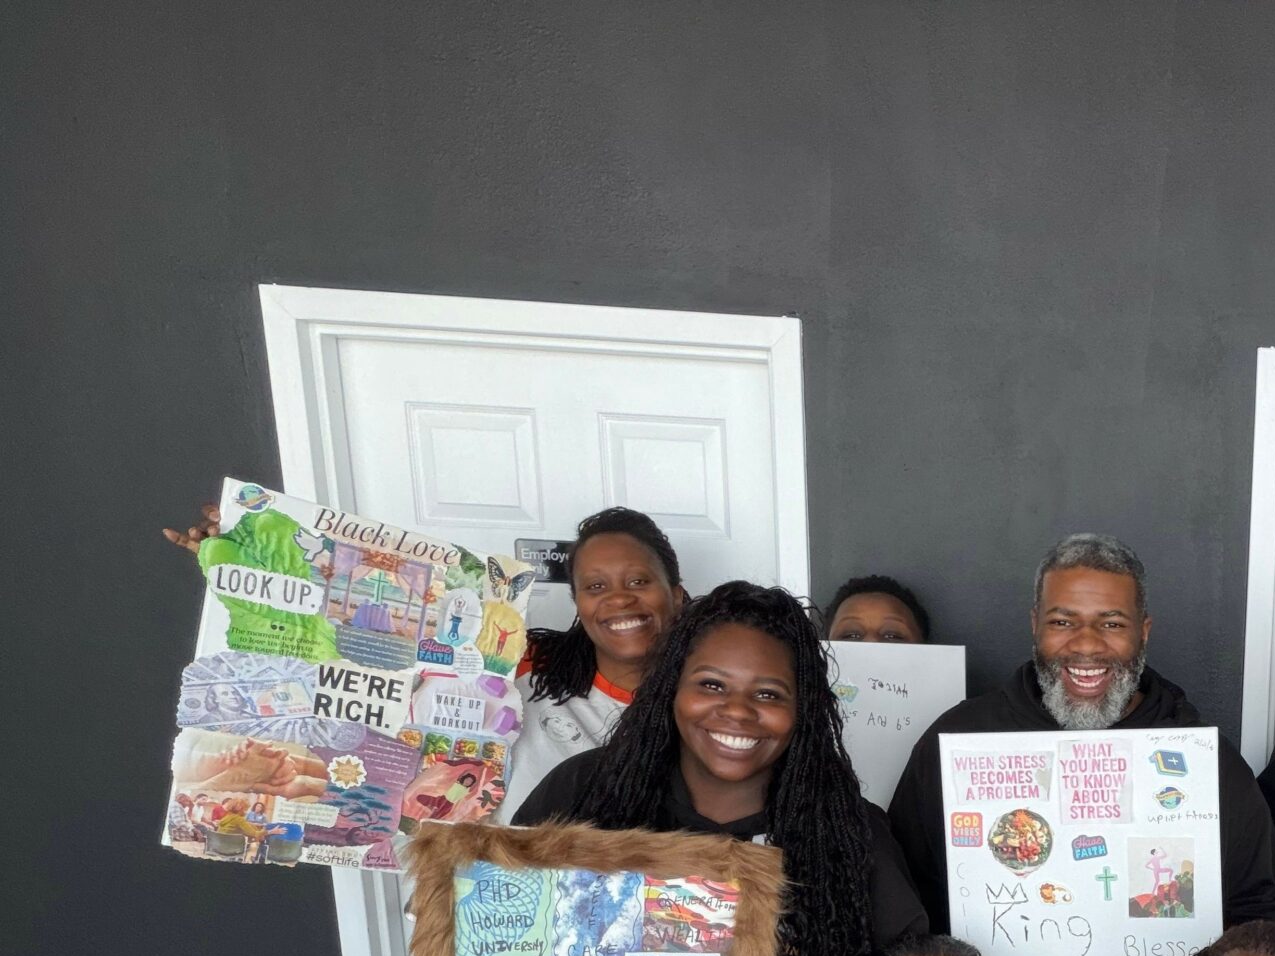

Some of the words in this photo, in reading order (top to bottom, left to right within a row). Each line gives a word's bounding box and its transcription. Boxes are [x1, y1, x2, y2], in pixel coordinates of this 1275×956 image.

[314, 508, 391, 548] Black
[396, 530, 460, 565] Love
[216, 566, 273, 599] LOOK
[284, 579, 316, 608] UP.
[419, 651, 452, 664] FAITH
[319, 664, 404, 703] WE'RE
[435, 694, 462, 708] WAKE
[469, 699, 481, 709] UP
[313, 692, 390, 729] RICH.
[433, 716, 481, 732] WORKOUT
[1072, 743, 1113, 759] WHAT
[954, 756, 994, 771] WHEN
[998, 755, 1047, 770] STRESS
[1060, 759, 1087, 774] YOU
[1091, 758, 1127, 773] NEED
[970, 770, 1033, 785] BECOMES
[1062, 775, 1079, 789] TO
[1084, 773, 1127, 789] KNOW
[966, 787, 976, 801] A
[978, 785, 1040, 801] PROBLEM
[1072, 789, 1119, 804] ABOUT
[1070, 804, 1121, 820] STRESS
[953, 815, 980, 828] GOD
[307, 853, 359, 868] #softlife
[1075, 846, 1106, 859] FAITH
[477, 880, 521, 904] PHD
[470, 911, 535, 933] HOWARD
